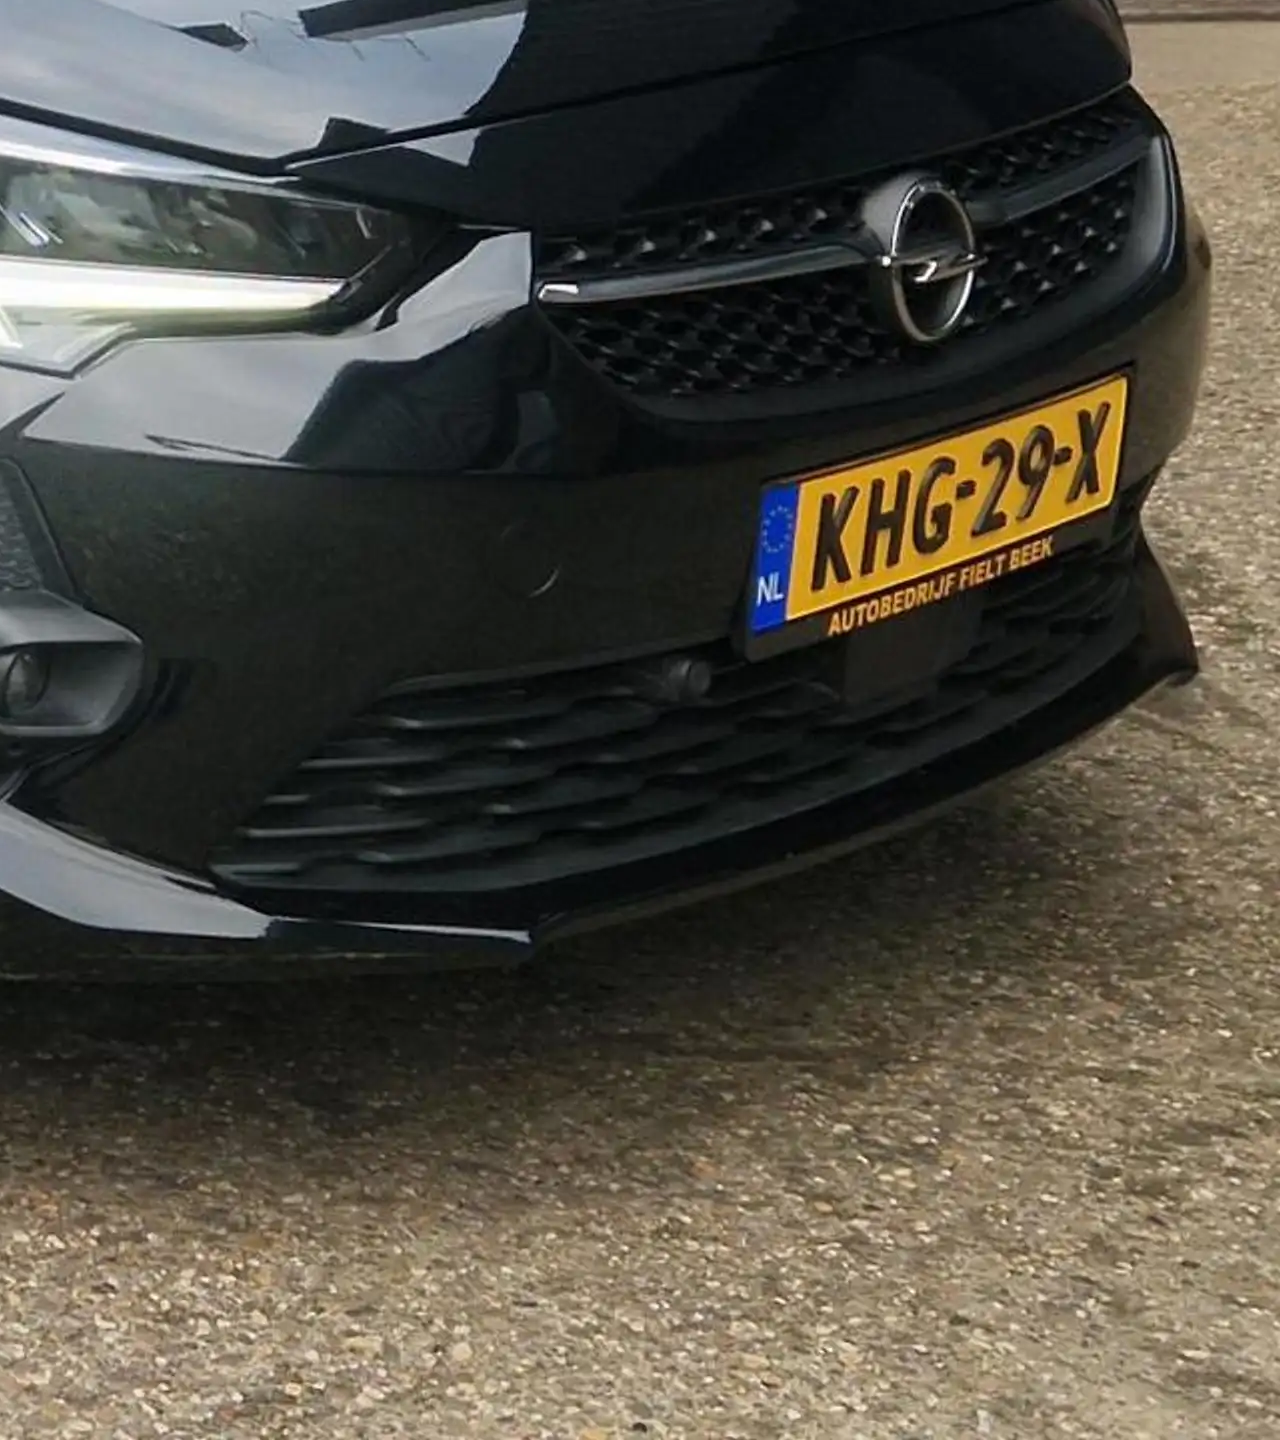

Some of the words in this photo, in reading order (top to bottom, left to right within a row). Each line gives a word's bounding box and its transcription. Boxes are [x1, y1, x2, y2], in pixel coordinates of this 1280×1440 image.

[809, 401, 1113, 592] KHG-29-X
[755, 576, 785, 607] NL
[827, 573, 957, 637] AUTOBEDRIJF
[958, 557, 1007, 593] FIELT
[1007, 535, 1055, 572] BEEK
